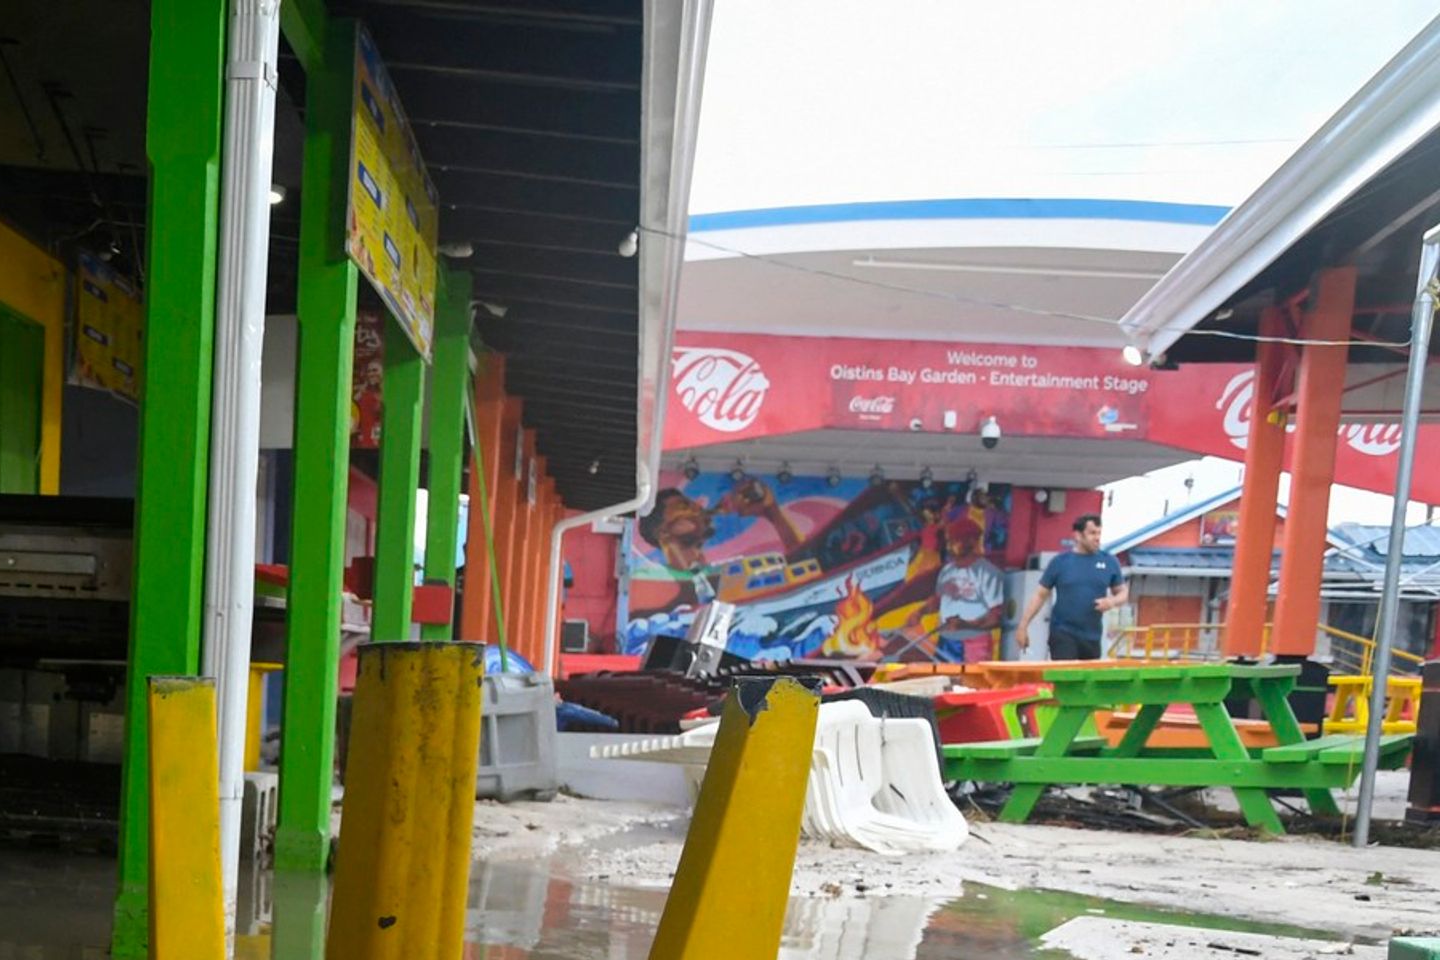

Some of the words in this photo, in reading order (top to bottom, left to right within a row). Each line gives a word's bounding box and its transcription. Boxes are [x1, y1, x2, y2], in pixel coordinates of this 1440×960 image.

[947, 350, 1017, 367] Welcome
[1022, 354, 1038, 368] to
[830, 364, 884, 381] Oistins
[887, 366, 916, 385] Bay
[920, 368, 977, 384] Garden
[989, 371, 1100, 390] Entertainment
[1103, 375, 1148, 394] Stage
